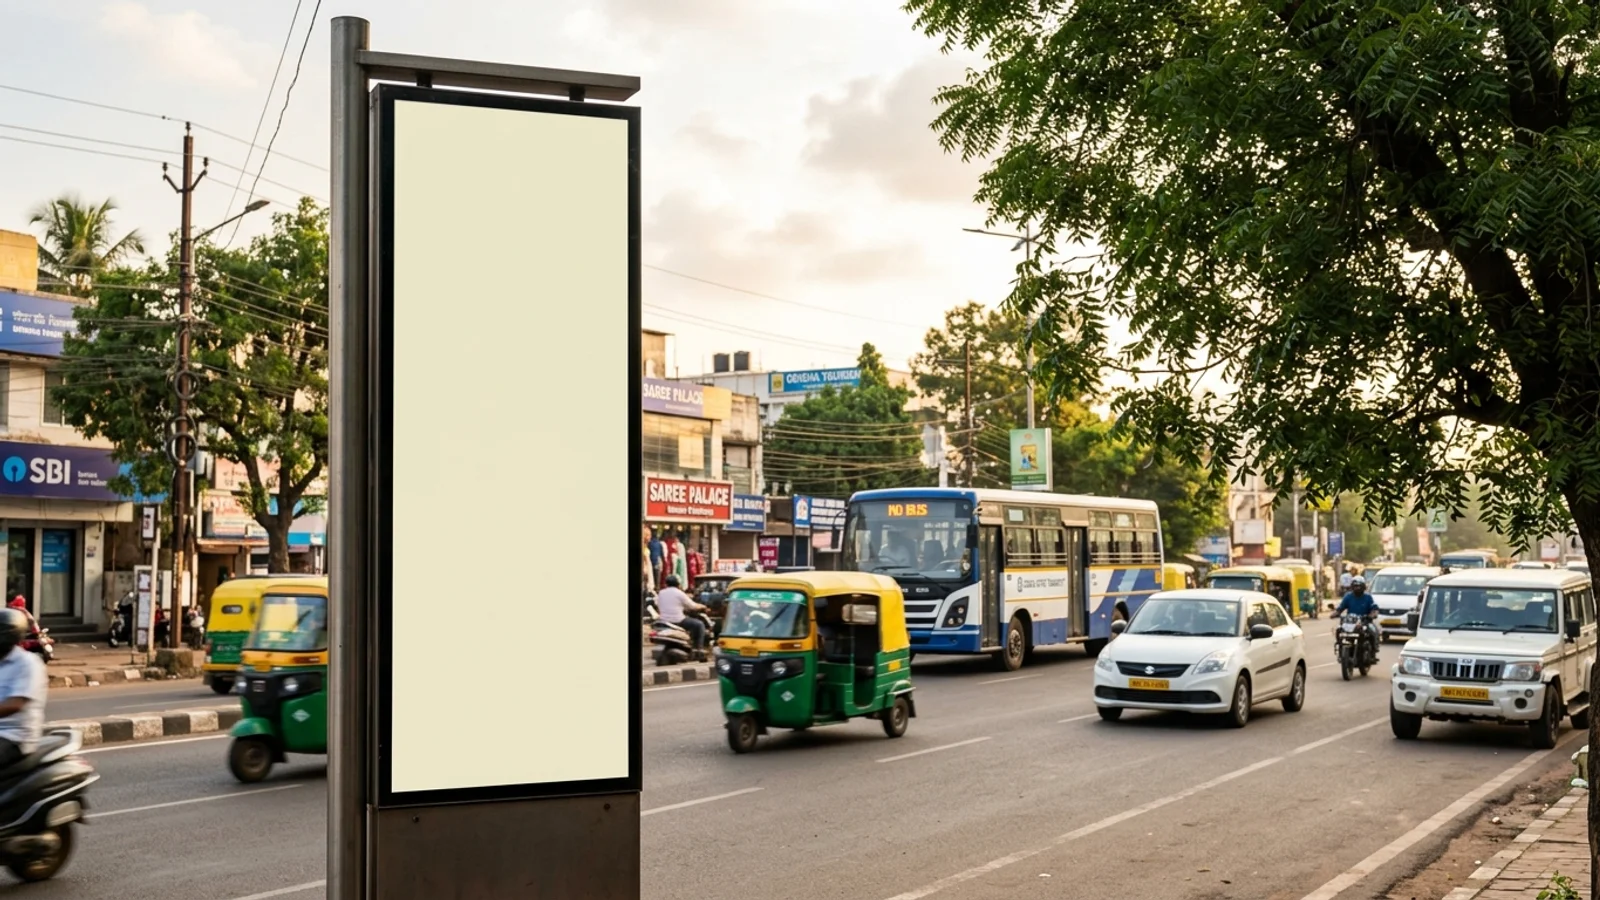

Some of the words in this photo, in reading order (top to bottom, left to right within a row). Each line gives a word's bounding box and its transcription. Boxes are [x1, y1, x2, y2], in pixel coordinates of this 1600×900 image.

[643, 383, 671, 401] SAREE
[29, 457, 71, 485] SBI
[649, 482, 687, 503] SAREE
[688, 485, 729, 506] PALACE
[905, 503, 928, 517] BUS
